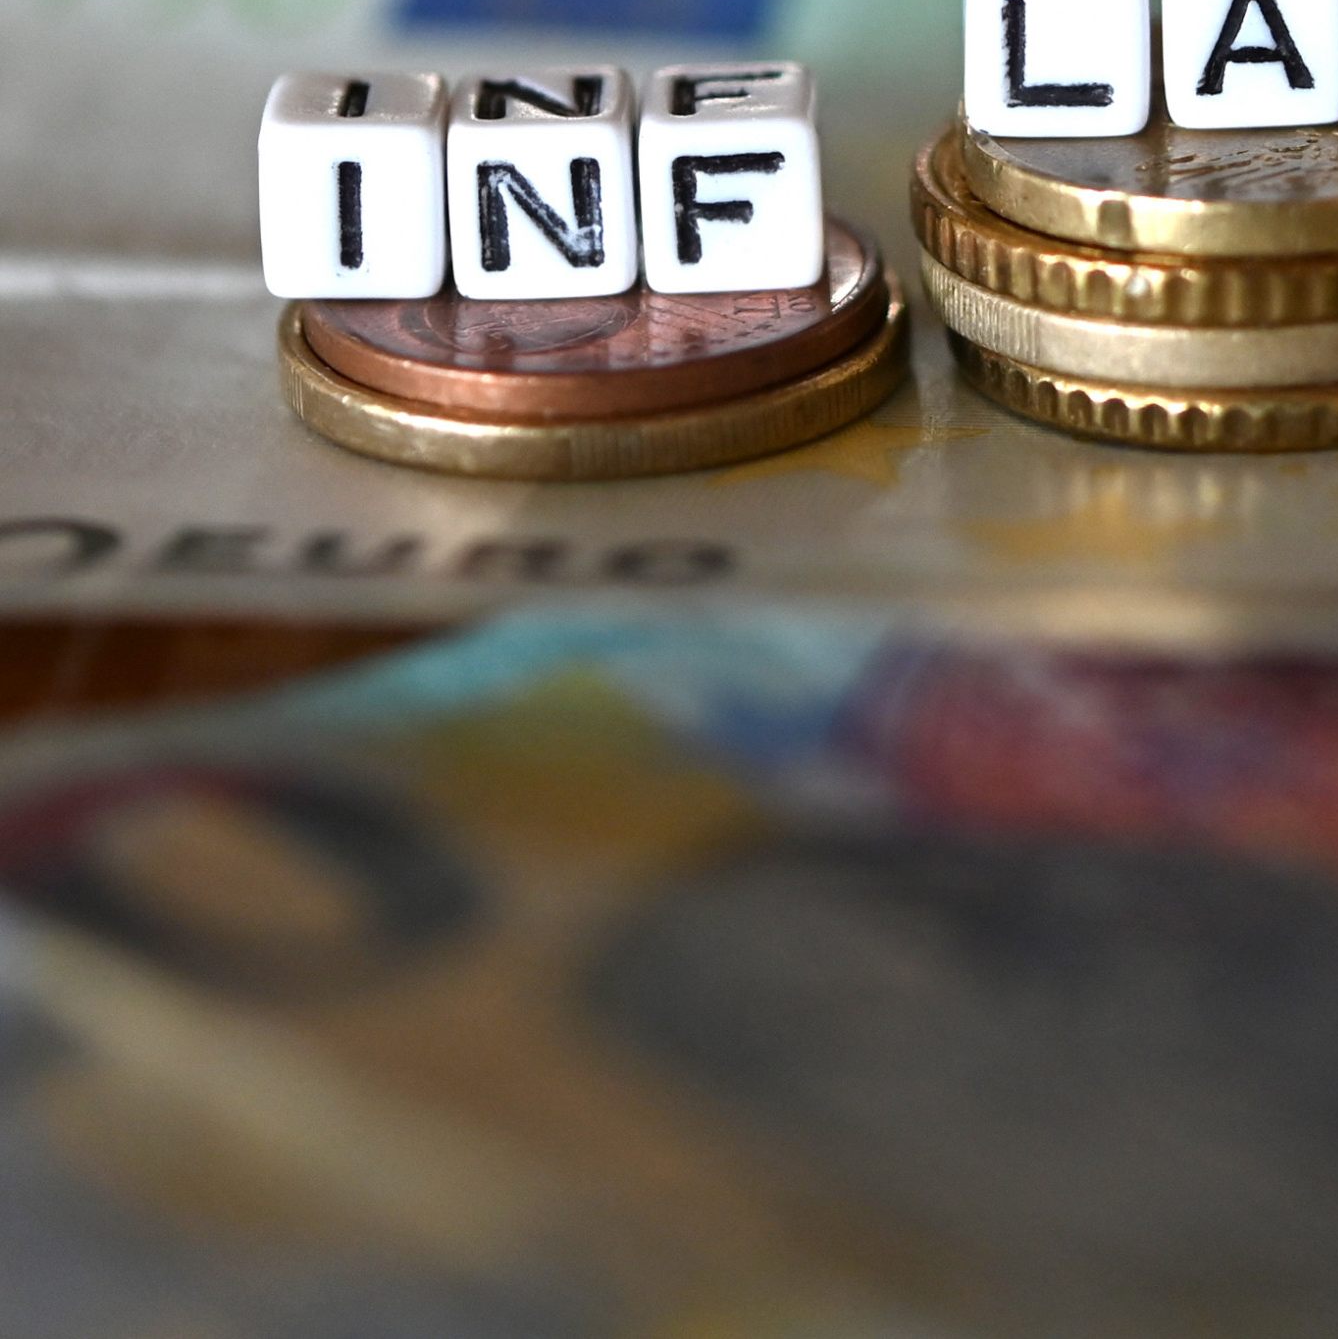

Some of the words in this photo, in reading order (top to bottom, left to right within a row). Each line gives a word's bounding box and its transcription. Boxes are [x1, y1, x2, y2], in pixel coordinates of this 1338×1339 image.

[337, 68, 785, 121] INF
[336, 151, 786, 272] INF
[152, 523, 735, 585] EURO
